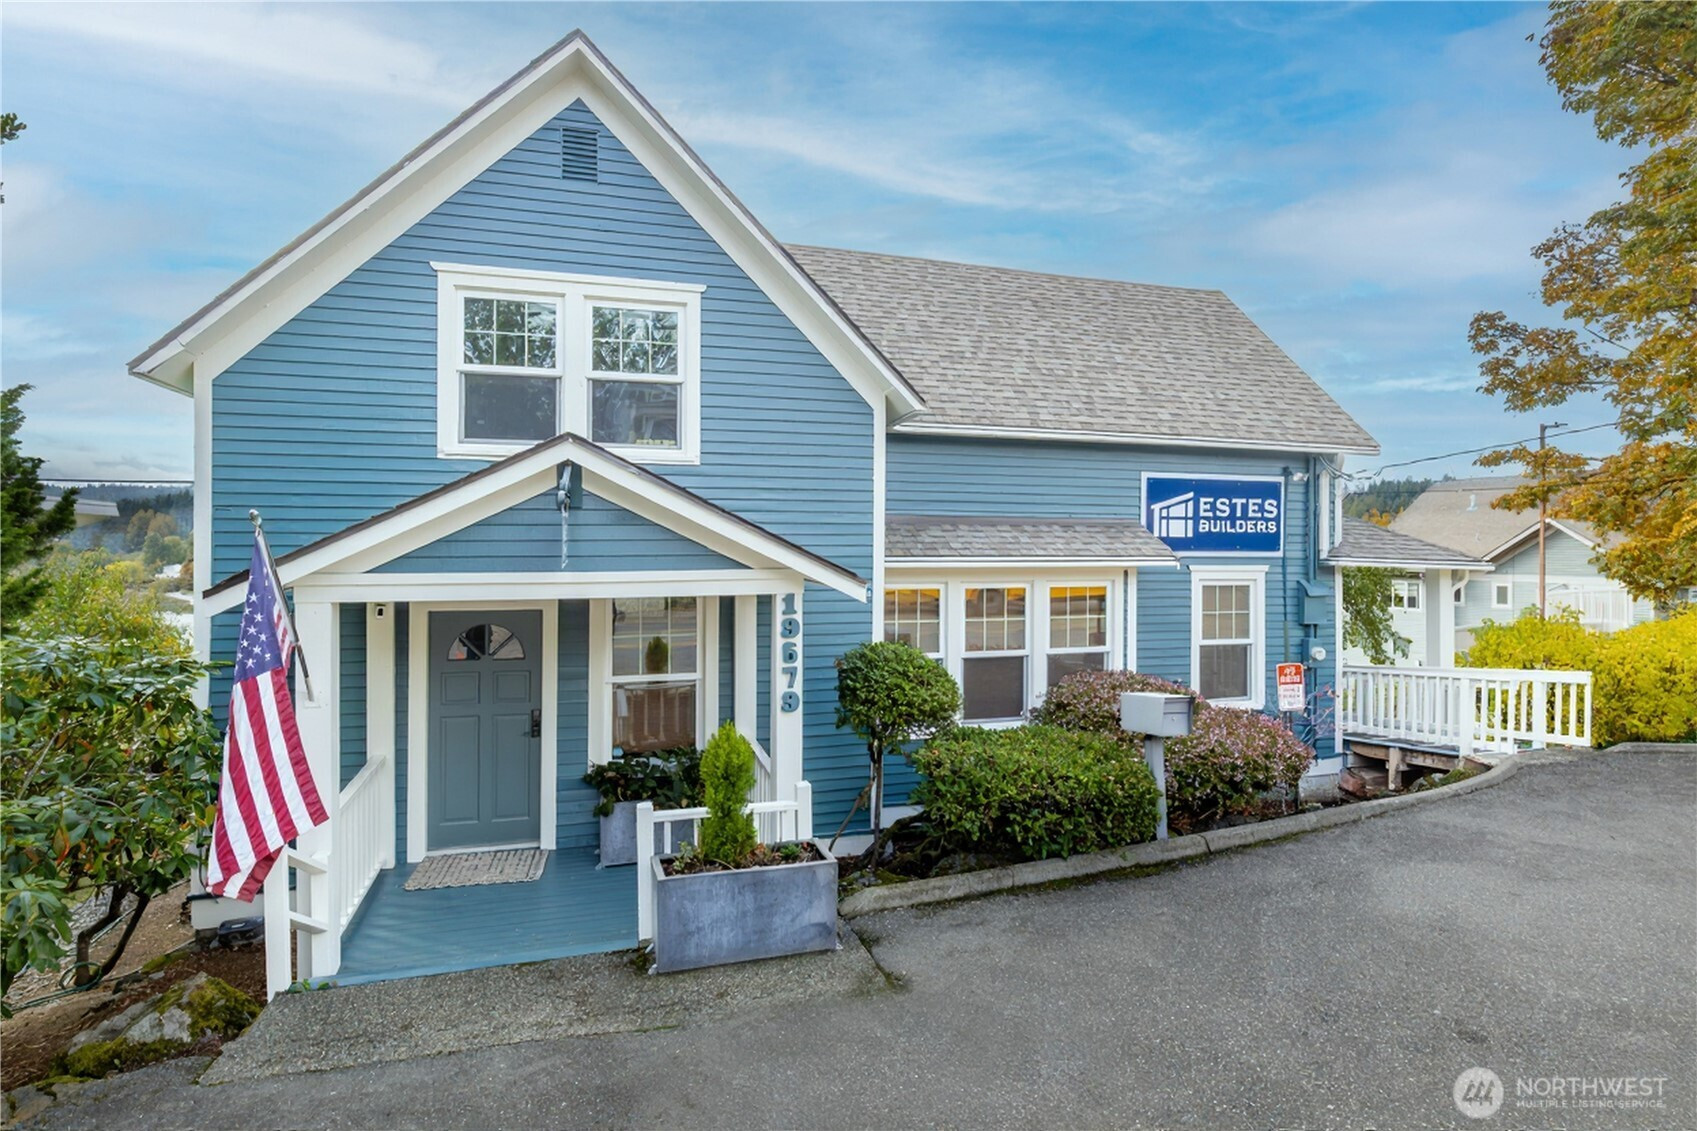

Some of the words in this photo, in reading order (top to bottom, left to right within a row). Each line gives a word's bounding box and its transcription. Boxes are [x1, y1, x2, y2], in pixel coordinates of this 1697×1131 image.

[1199, 497, 1278, 518] ESTES
[1198, 519, 1277, 533] BUILDERS
[780, 593, 801, 713] 19679
